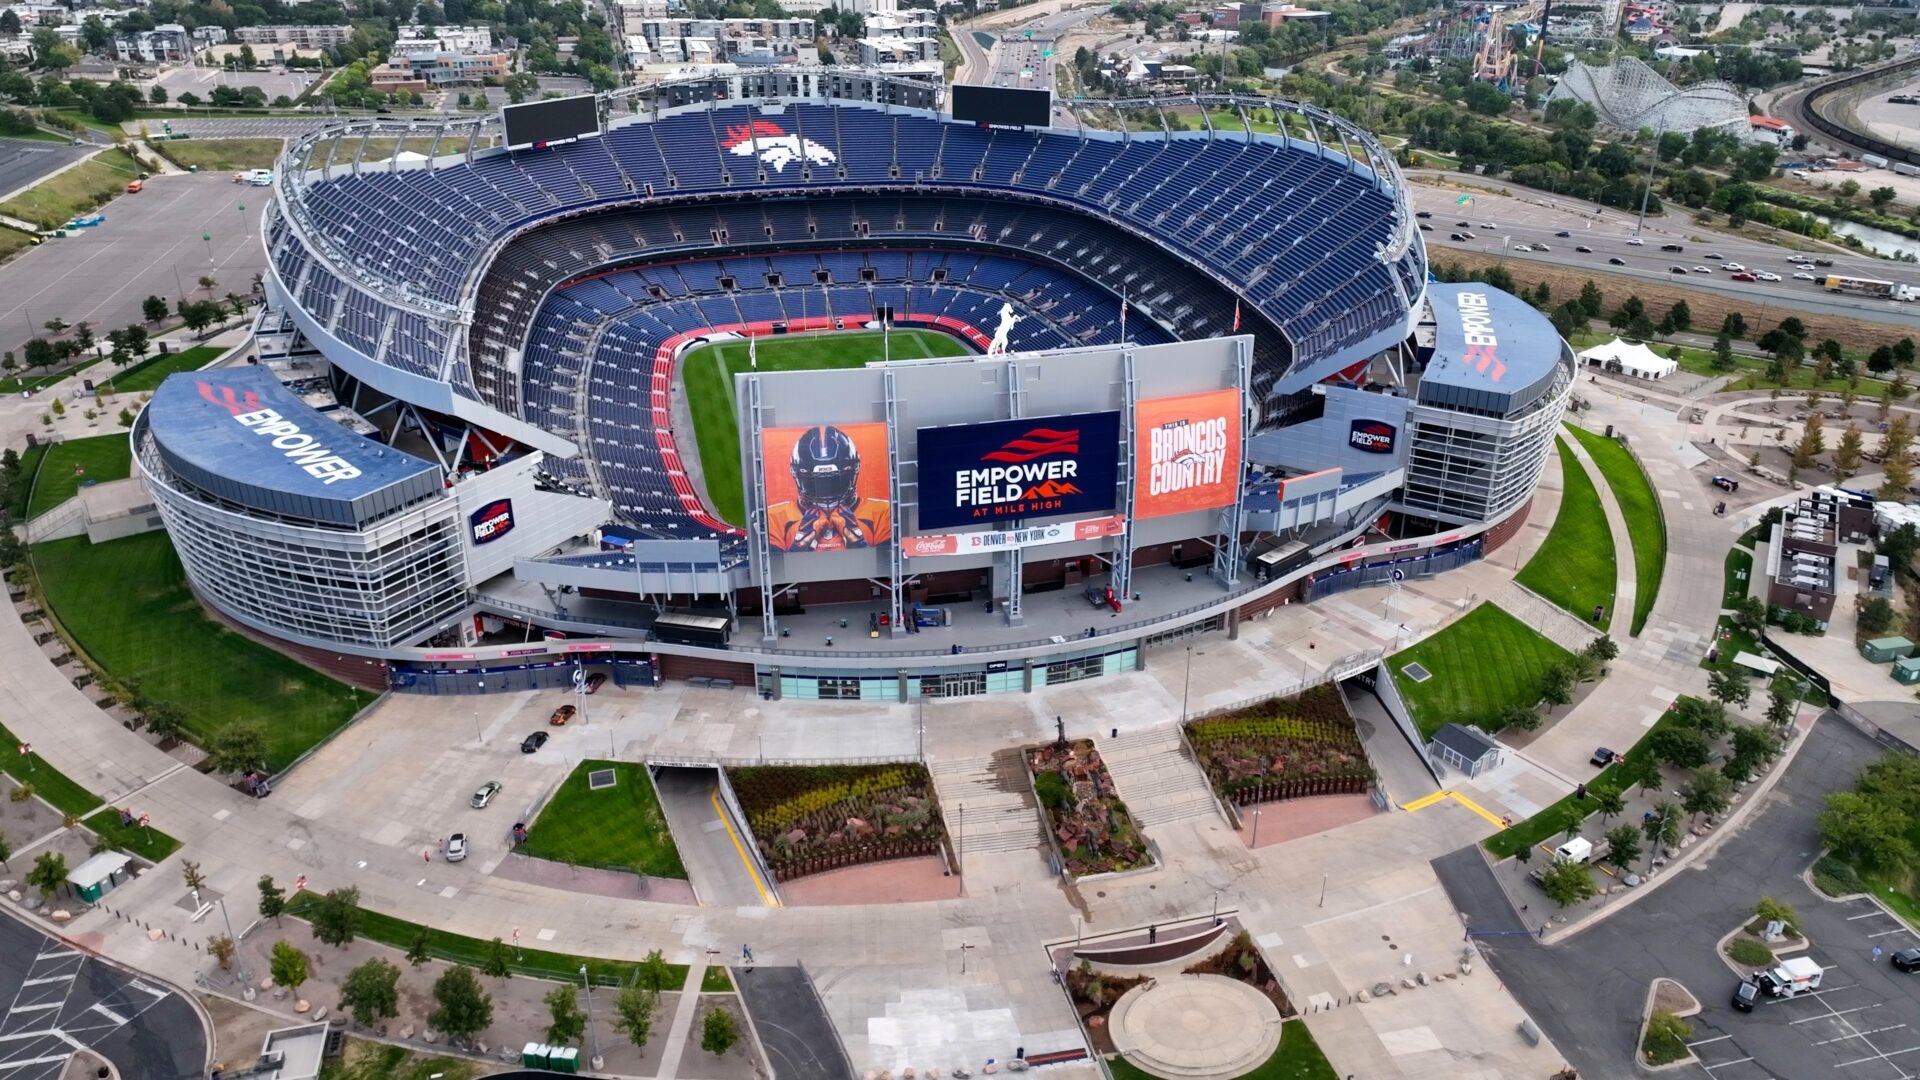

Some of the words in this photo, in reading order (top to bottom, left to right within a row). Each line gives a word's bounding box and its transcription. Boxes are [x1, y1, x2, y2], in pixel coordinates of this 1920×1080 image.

[1457, 292, 1497, 346] EMPOWER
[233, 408, 362, 485] EMPOWER
[1150, 416, 1227, 465] BRONCOS
[1352, 431, 1391, 443] EMPOWER
[1352, 436, 1373, 445] FIELD
[956, 460, 1078, 489] EMPOWER
[1150, 448, 1227, 496] COUNTRY
[956, 484, 1023, 507] FIELD
[973, 508, 989, 518] AT
[995, 504, 1025, 514] MILE
[1031, 500, 1062, 511] HIGH
[474, 512, 509, 533] EMPOWER
[474, 525, 495, 540] FIELD
[983, 533, 1007, 546] DENVER
[1014, 531, 1029, 543] NEW
[1030, 529, 1046, 541] YORK
